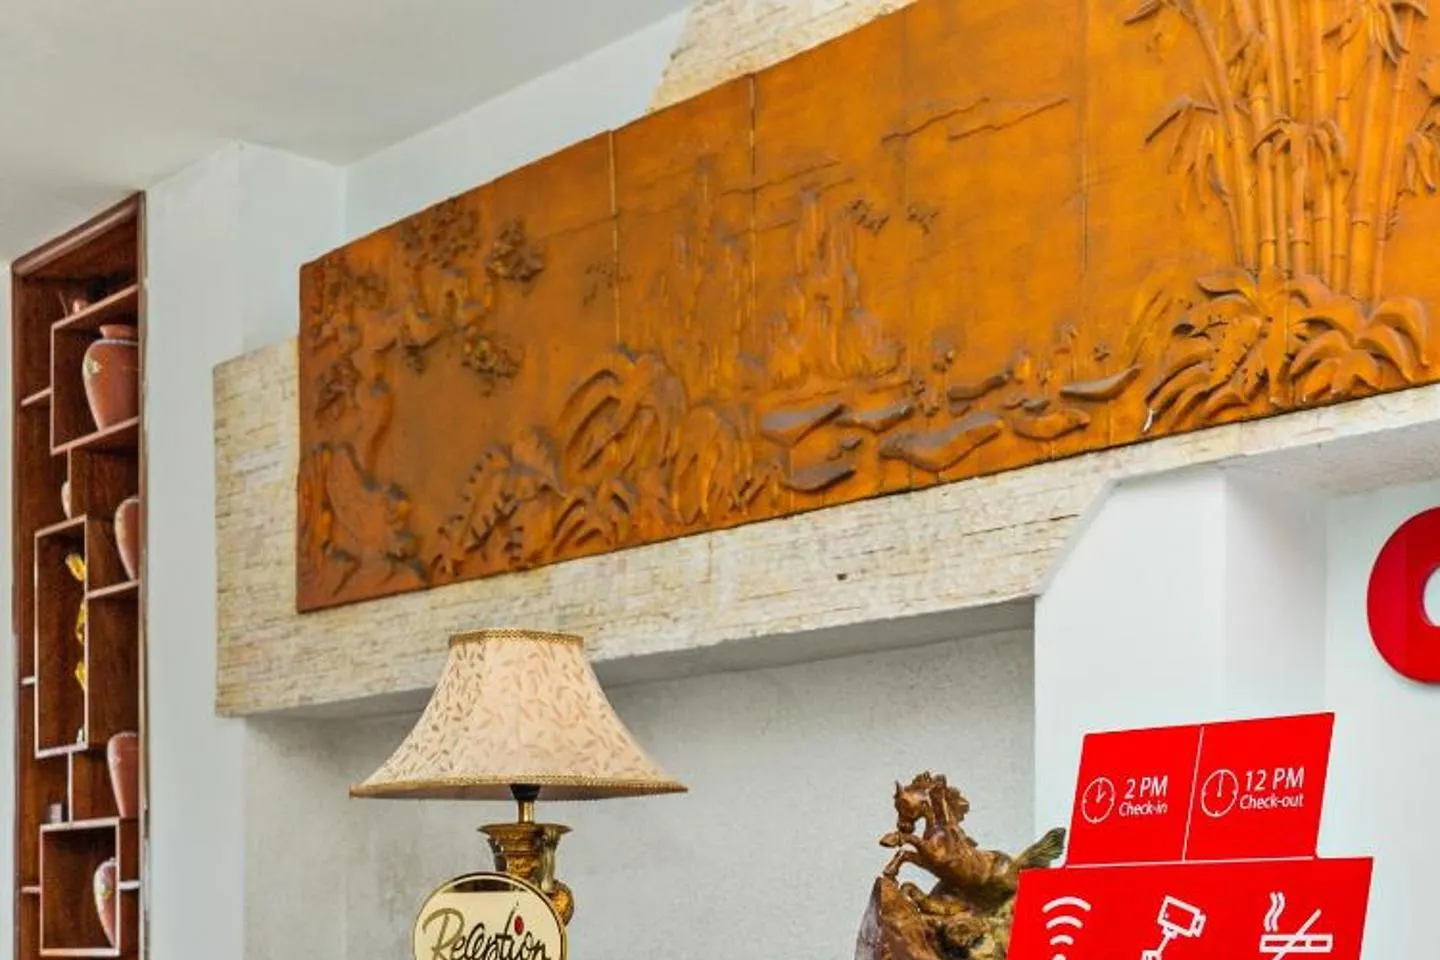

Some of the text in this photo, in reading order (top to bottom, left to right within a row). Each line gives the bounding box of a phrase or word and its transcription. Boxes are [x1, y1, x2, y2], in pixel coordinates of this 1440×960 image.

[1124, 775, 1169, 800] 2 PM
[1245, 766, 1305, 792] 12 PM
[1118, 800, 1169, 817] Check-in
[1239, 793, 1305, 810] Check-out
